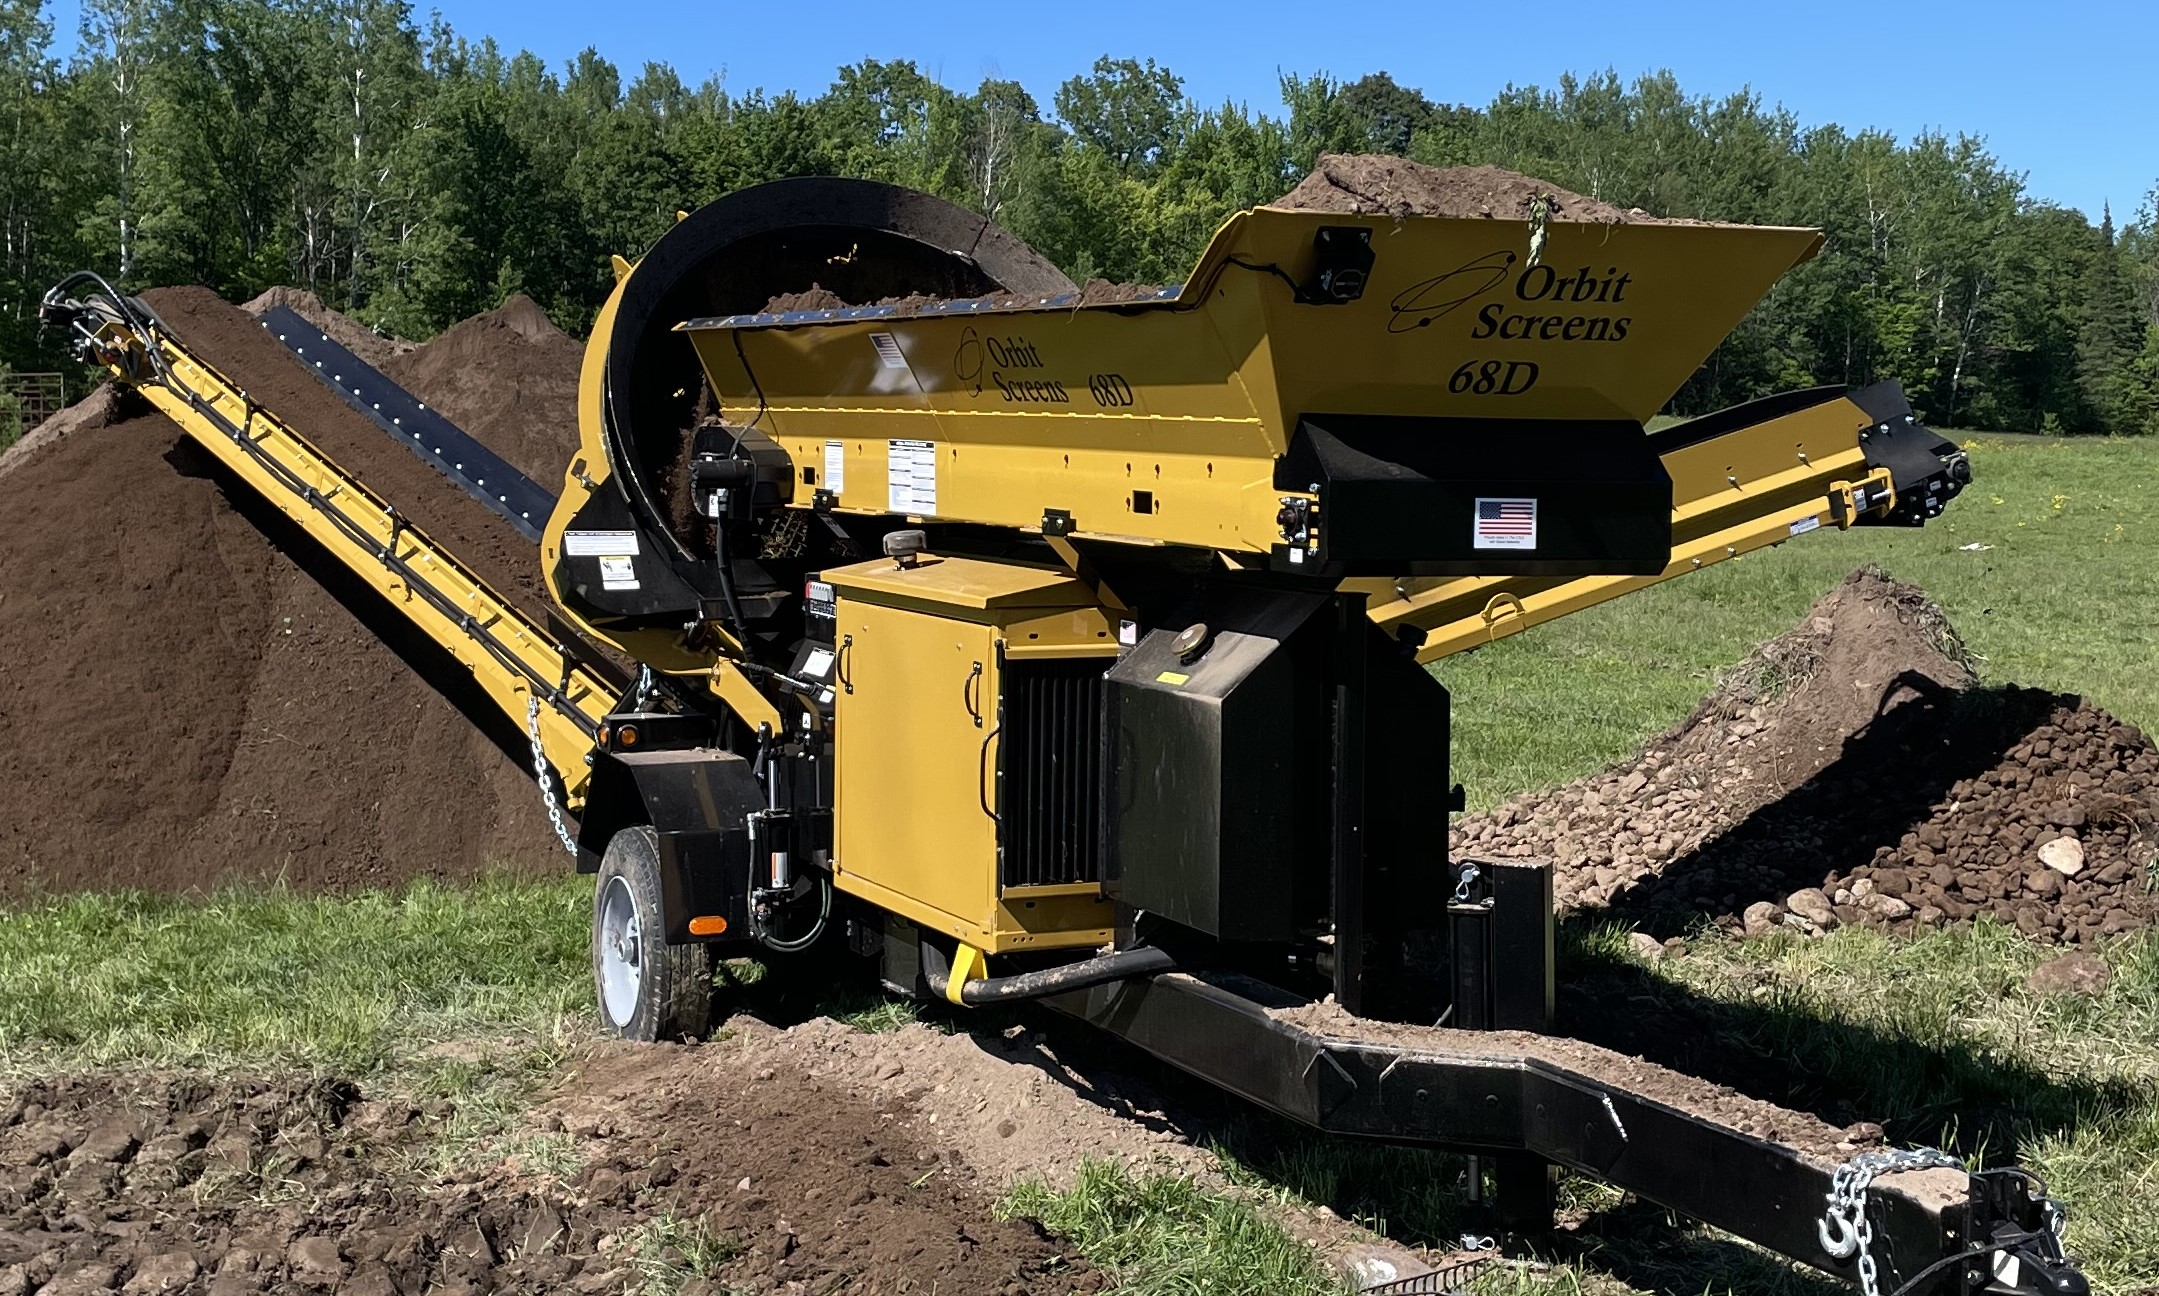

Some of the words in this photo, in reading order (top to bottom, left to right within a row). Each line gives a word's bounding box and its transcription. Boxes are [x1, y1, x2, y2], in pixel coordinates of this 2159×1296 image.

[1516, 264, 1632, 302] Orbit
[1471, 303, 1632, 341] Screens
[986, 336, 1044, 368] Orbit
[992, 371, 1069, 403] Screens
[1089, 373, 1134, 406] 68D
[1448, 360, 1539, 395] 68D
